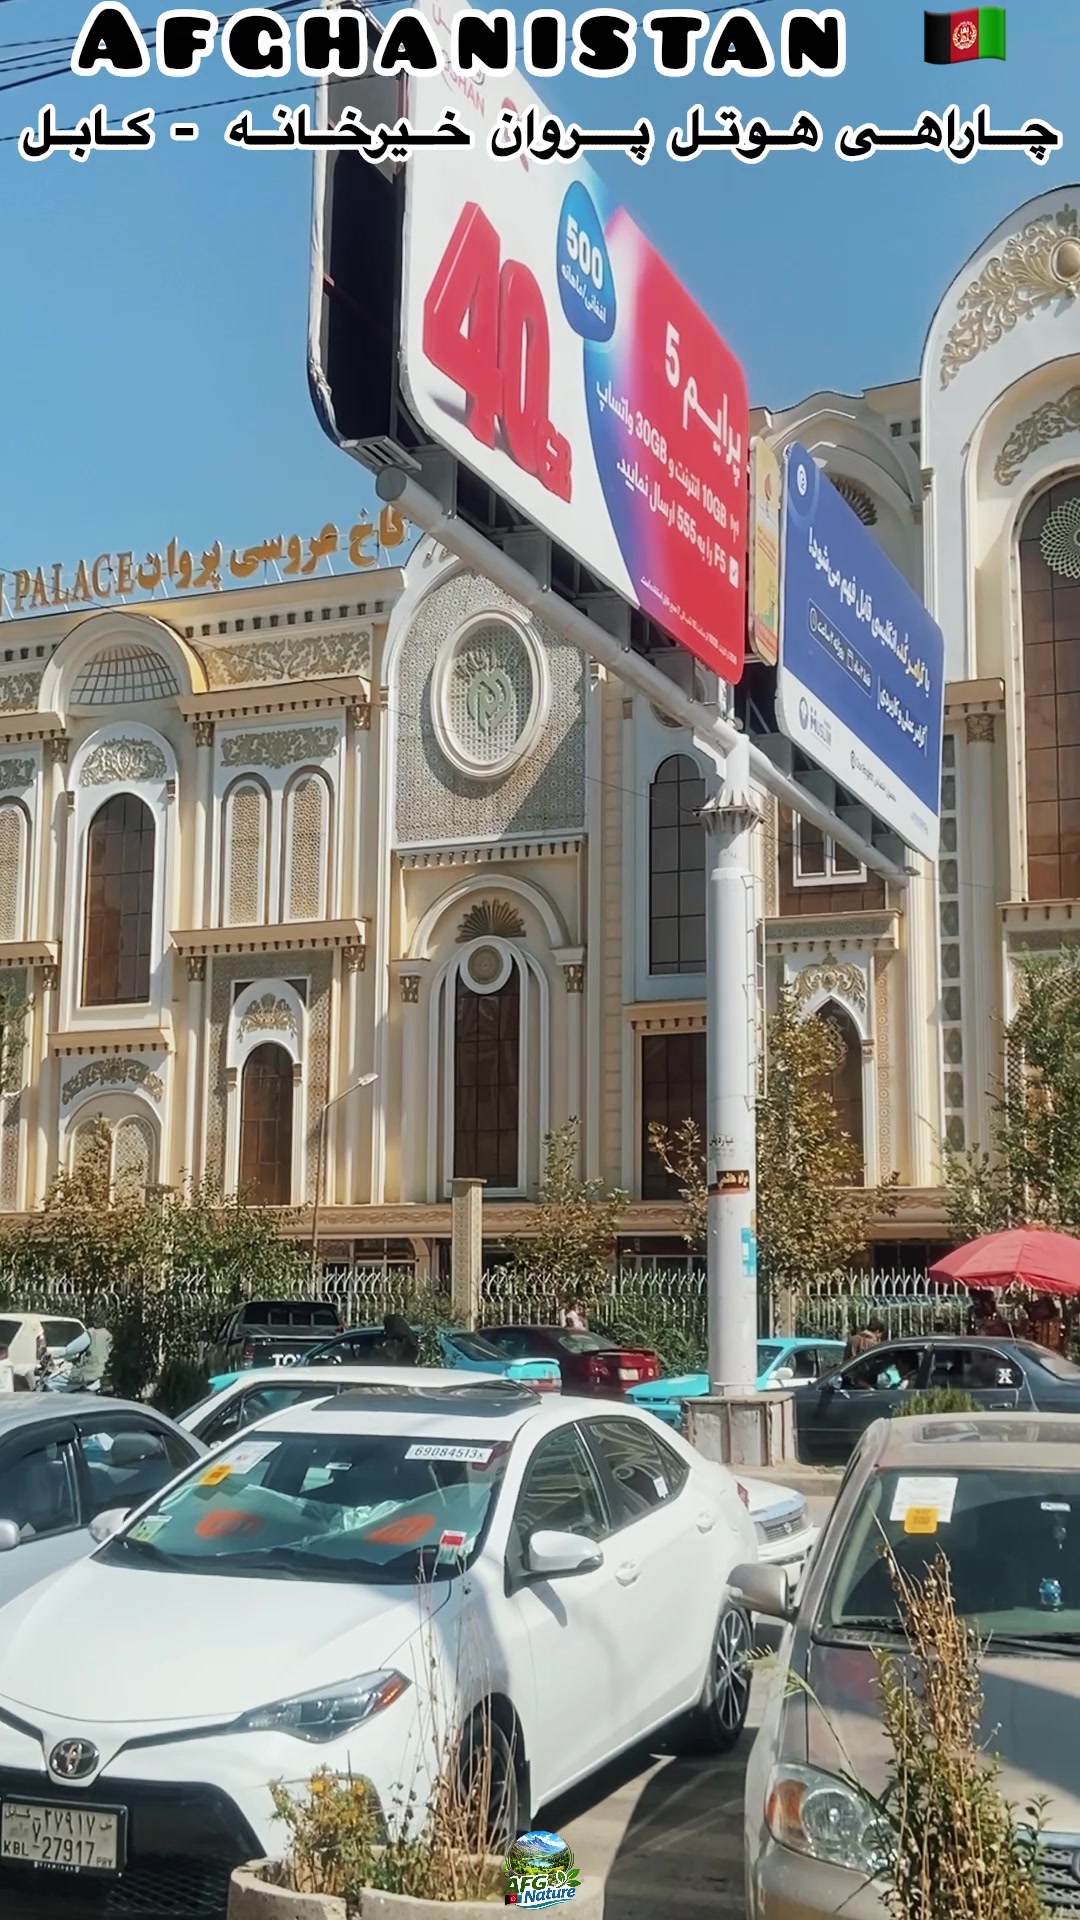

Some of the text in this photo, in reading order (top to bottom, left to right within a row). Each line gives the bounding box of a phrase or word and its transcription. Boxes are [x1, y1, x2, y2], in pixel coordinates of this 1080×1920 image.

[566, 214, 603, 290] 500
[596, 380, 634, 435] واتساپ
[665, 321, 741, 487] پرایم 5
[635, 411, 667, 464] 30GB
[668, 458, 675, 478] و
[649, 481, 675, 527] ارسال
[676, 504, 697, 544] 555
[701, 484, 727, 529] 10GB
[137, 536, 223, 591] پروان
[230, 523, 338, 578] عروسی
[706, 536, 713, 567] را
[714, 542, 726, 574] F5
[13, 551, 134, 611] PALACE
[3, 1840, 29, 1857] KBL
[41, 1836, 95, 1864] 27917
